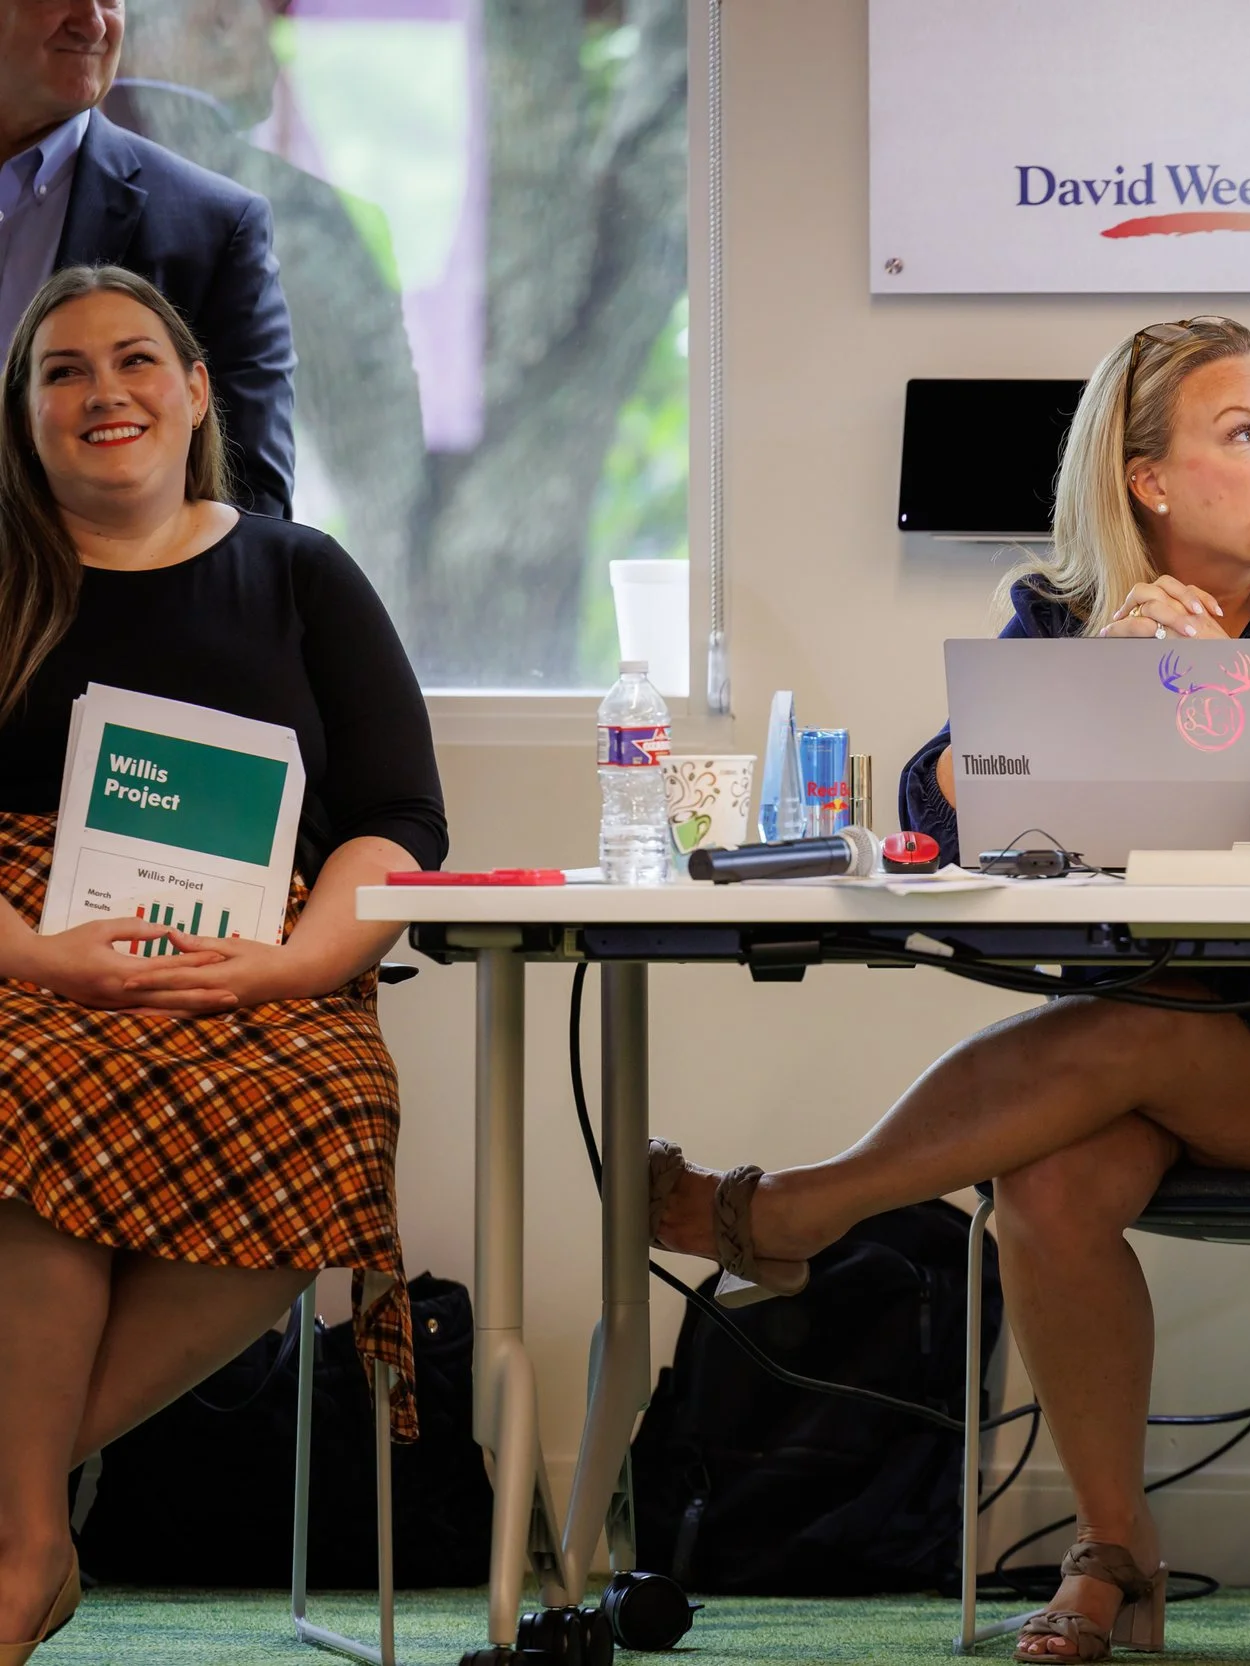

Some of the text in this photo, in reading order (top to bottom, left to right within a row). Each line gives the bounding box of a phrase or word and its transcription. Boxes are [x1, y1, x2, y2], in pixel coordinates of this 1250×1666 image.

[1015, 162, 1156, 207] David
[110, 753, 168, 783] Willis
[962, 755, 1030, 775] ThinkBook
[104, 778, 180, 811] Project
[807, 782, 838, 797] Red
[138, 868, 204, 890] Willis Project
[88, 888, 112, 899] March
[84, 900, 111, 912] Results
